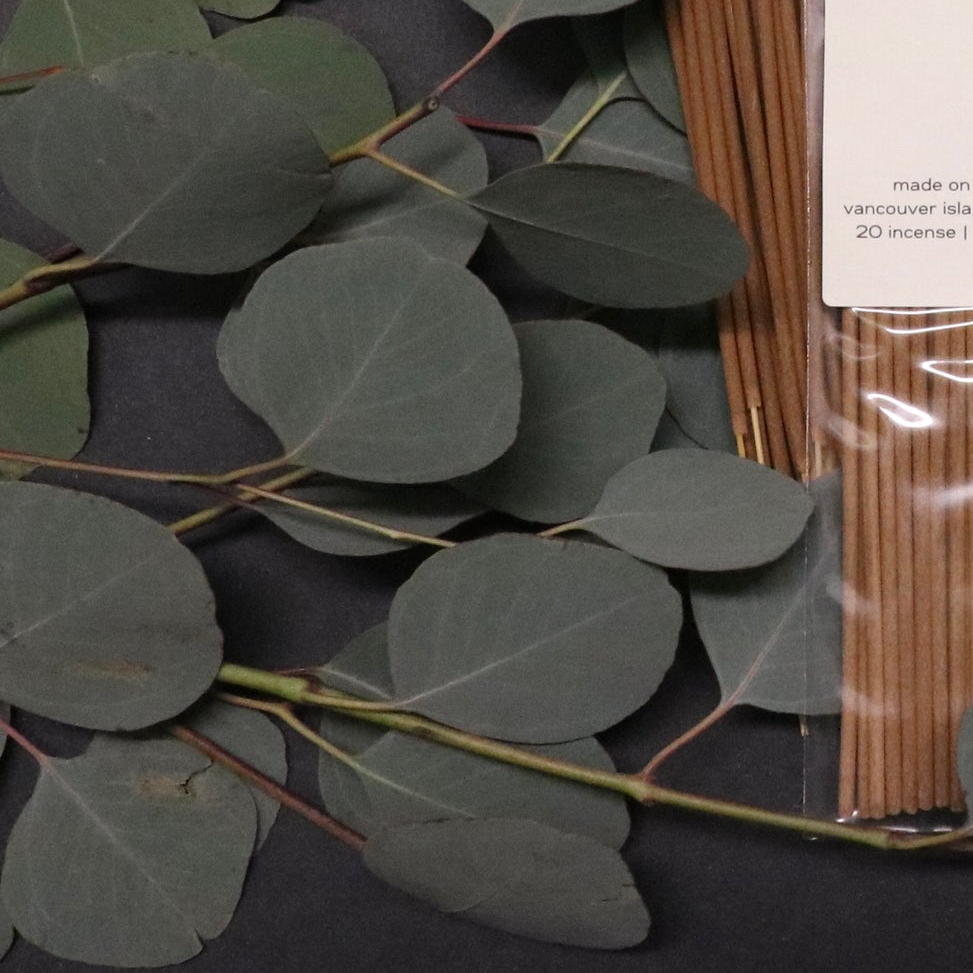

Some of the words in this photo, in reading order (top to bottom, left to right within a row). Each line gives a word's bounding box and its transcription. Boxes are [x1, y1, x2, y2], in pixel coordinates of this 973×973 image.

[893, 178, 943, 192] made
[948, 181, 971, 192] on
[843, 205, 937, 216] vancouver
[855, 224, 883, 239] 20
[888, 225, 956, 239] incense
